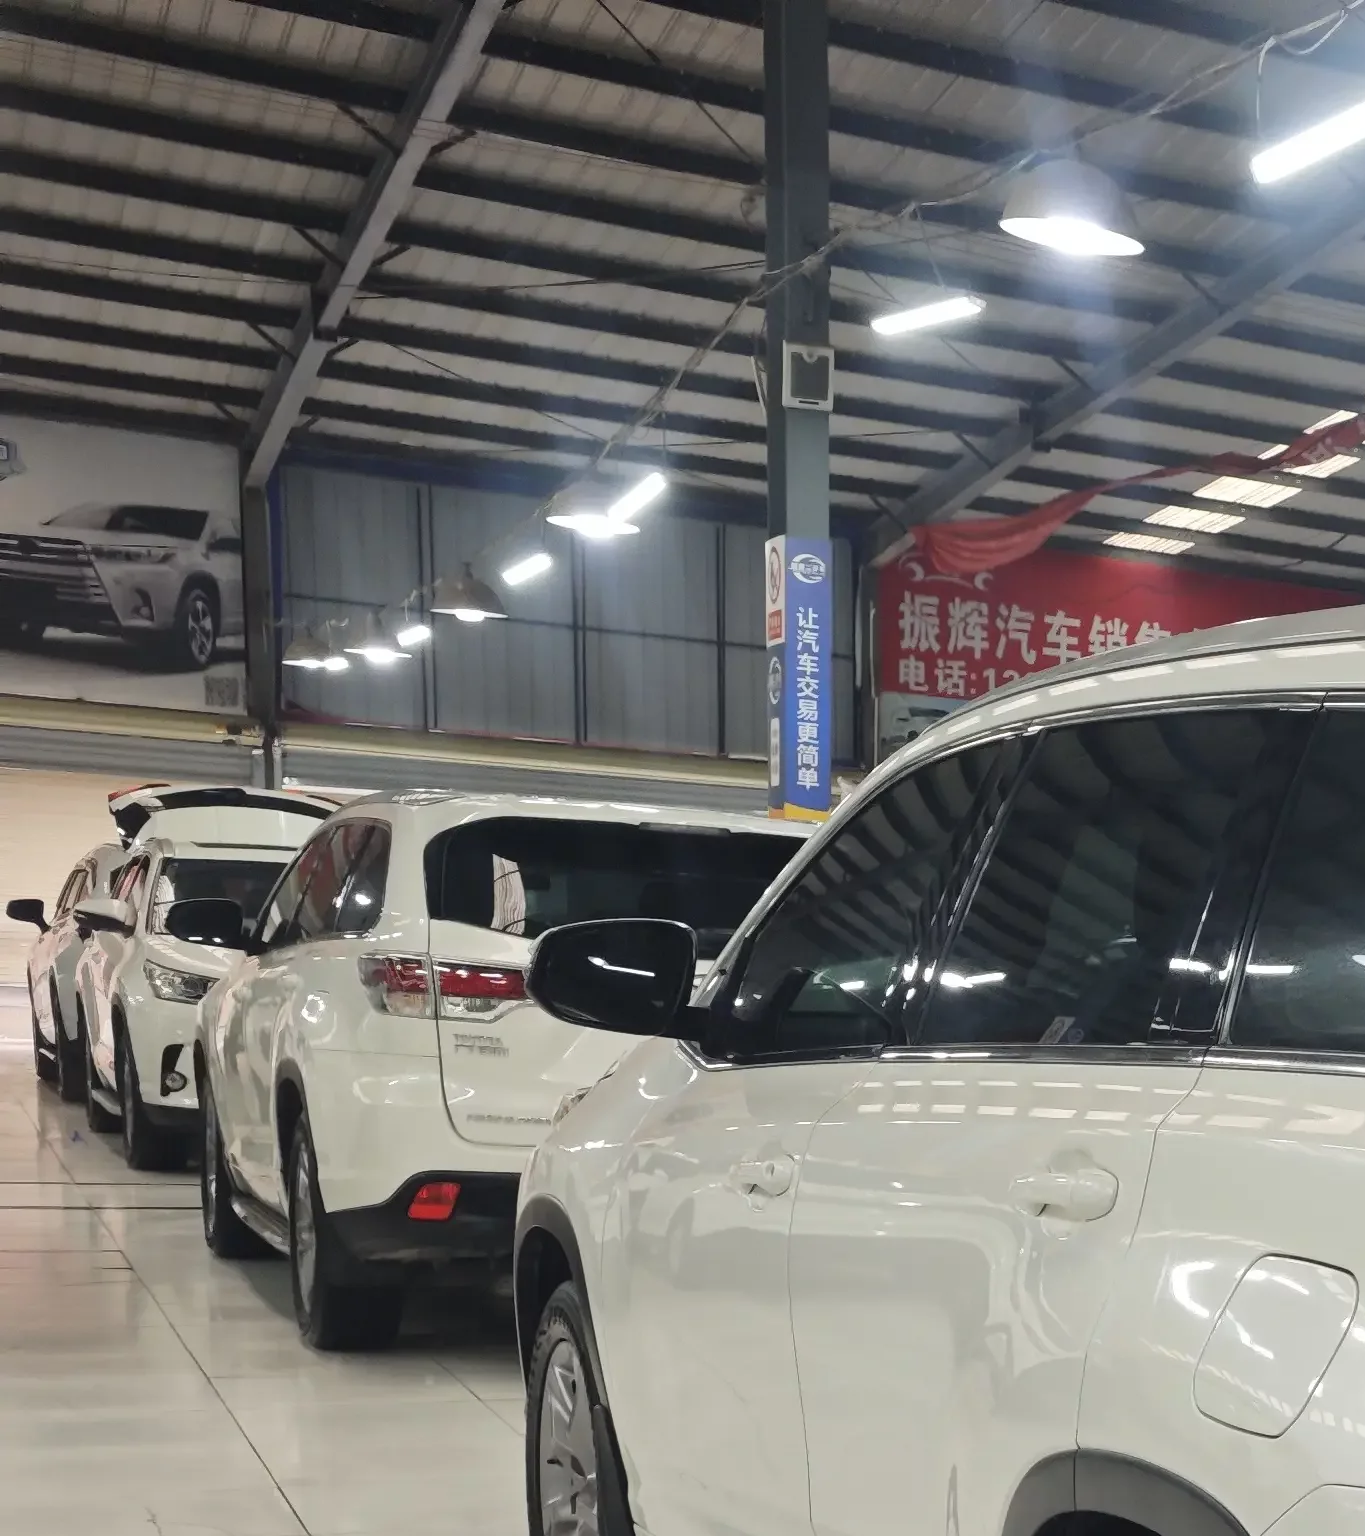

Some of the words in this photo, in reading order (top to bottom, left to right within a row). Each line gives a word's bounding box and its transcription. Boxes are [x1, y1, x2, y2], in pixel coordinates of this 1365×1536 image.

[796, 606, 820, 792] 让汽车交易更简单
